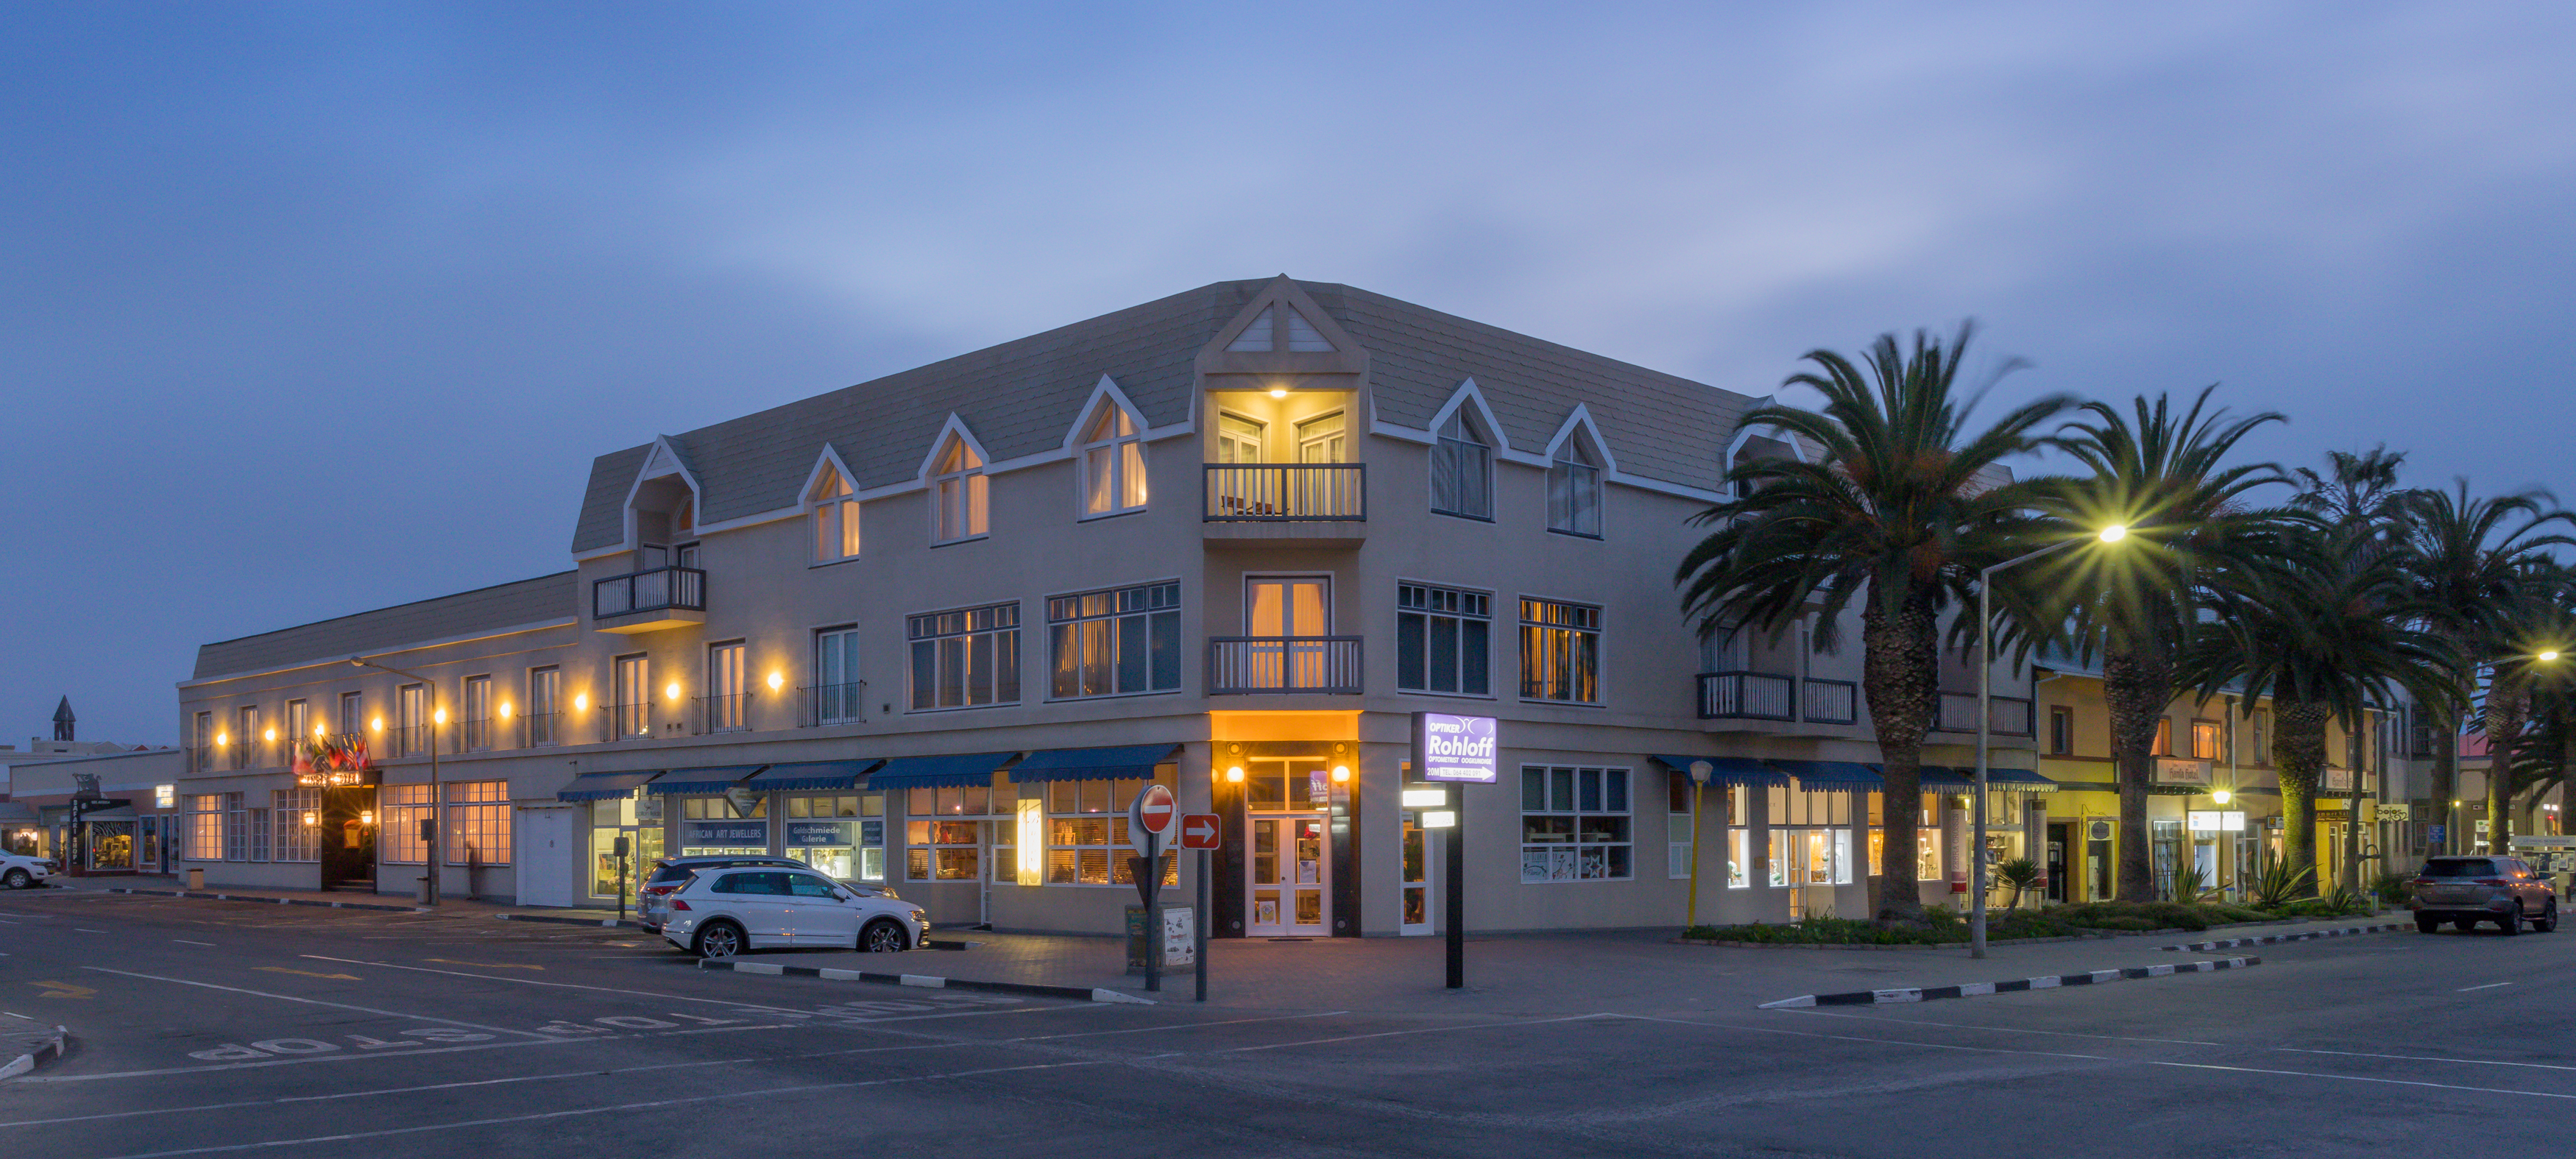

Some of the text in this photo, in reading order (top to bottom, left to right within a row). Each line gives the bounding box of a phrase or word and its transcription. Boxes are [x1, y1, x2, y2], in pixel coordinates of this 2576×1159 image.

[1429, 723, 1460, 733] OPTIKER
[1429, 735, 1494, 756] Rohloff
[1429, 756, 1493, 765] OPTOMETRIST OOGKUNDIGE
[1427, 768, 1440, 776] 20M
[689, 829, 762, 838] AFRICAN ART JEWELLERS
[188, 1028, 496, 1060] STOP
